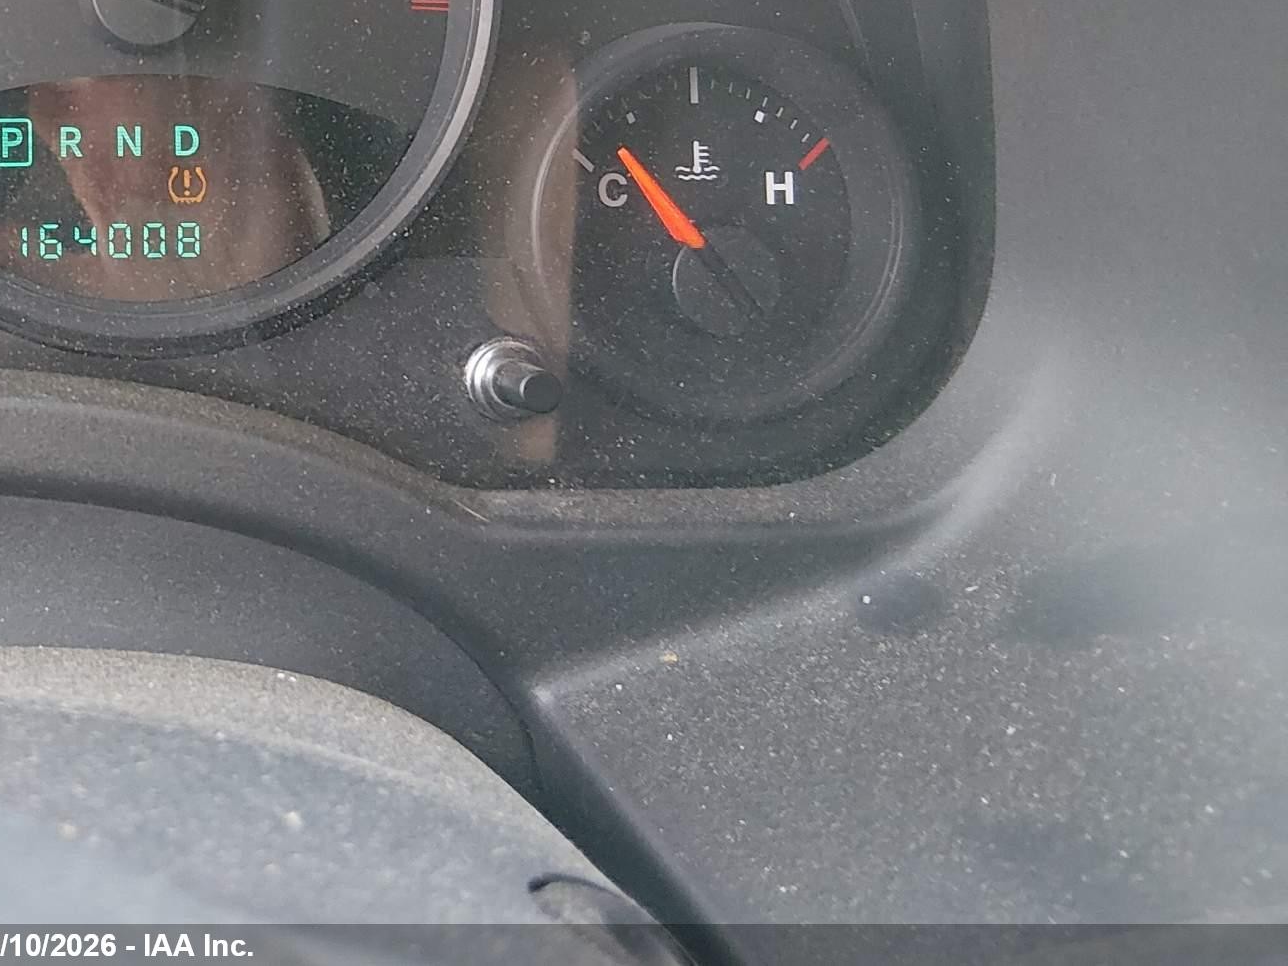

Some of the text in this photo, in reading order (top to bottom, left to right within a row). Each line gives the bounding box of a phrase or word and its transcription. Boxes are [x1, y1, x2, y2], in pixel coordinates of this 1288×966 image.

[2, 125, 199, 158] P R N D
[599, 173, 629, 207] C
[766, 171, 794, 205] H
[20, 222, 201, 259] 164008
